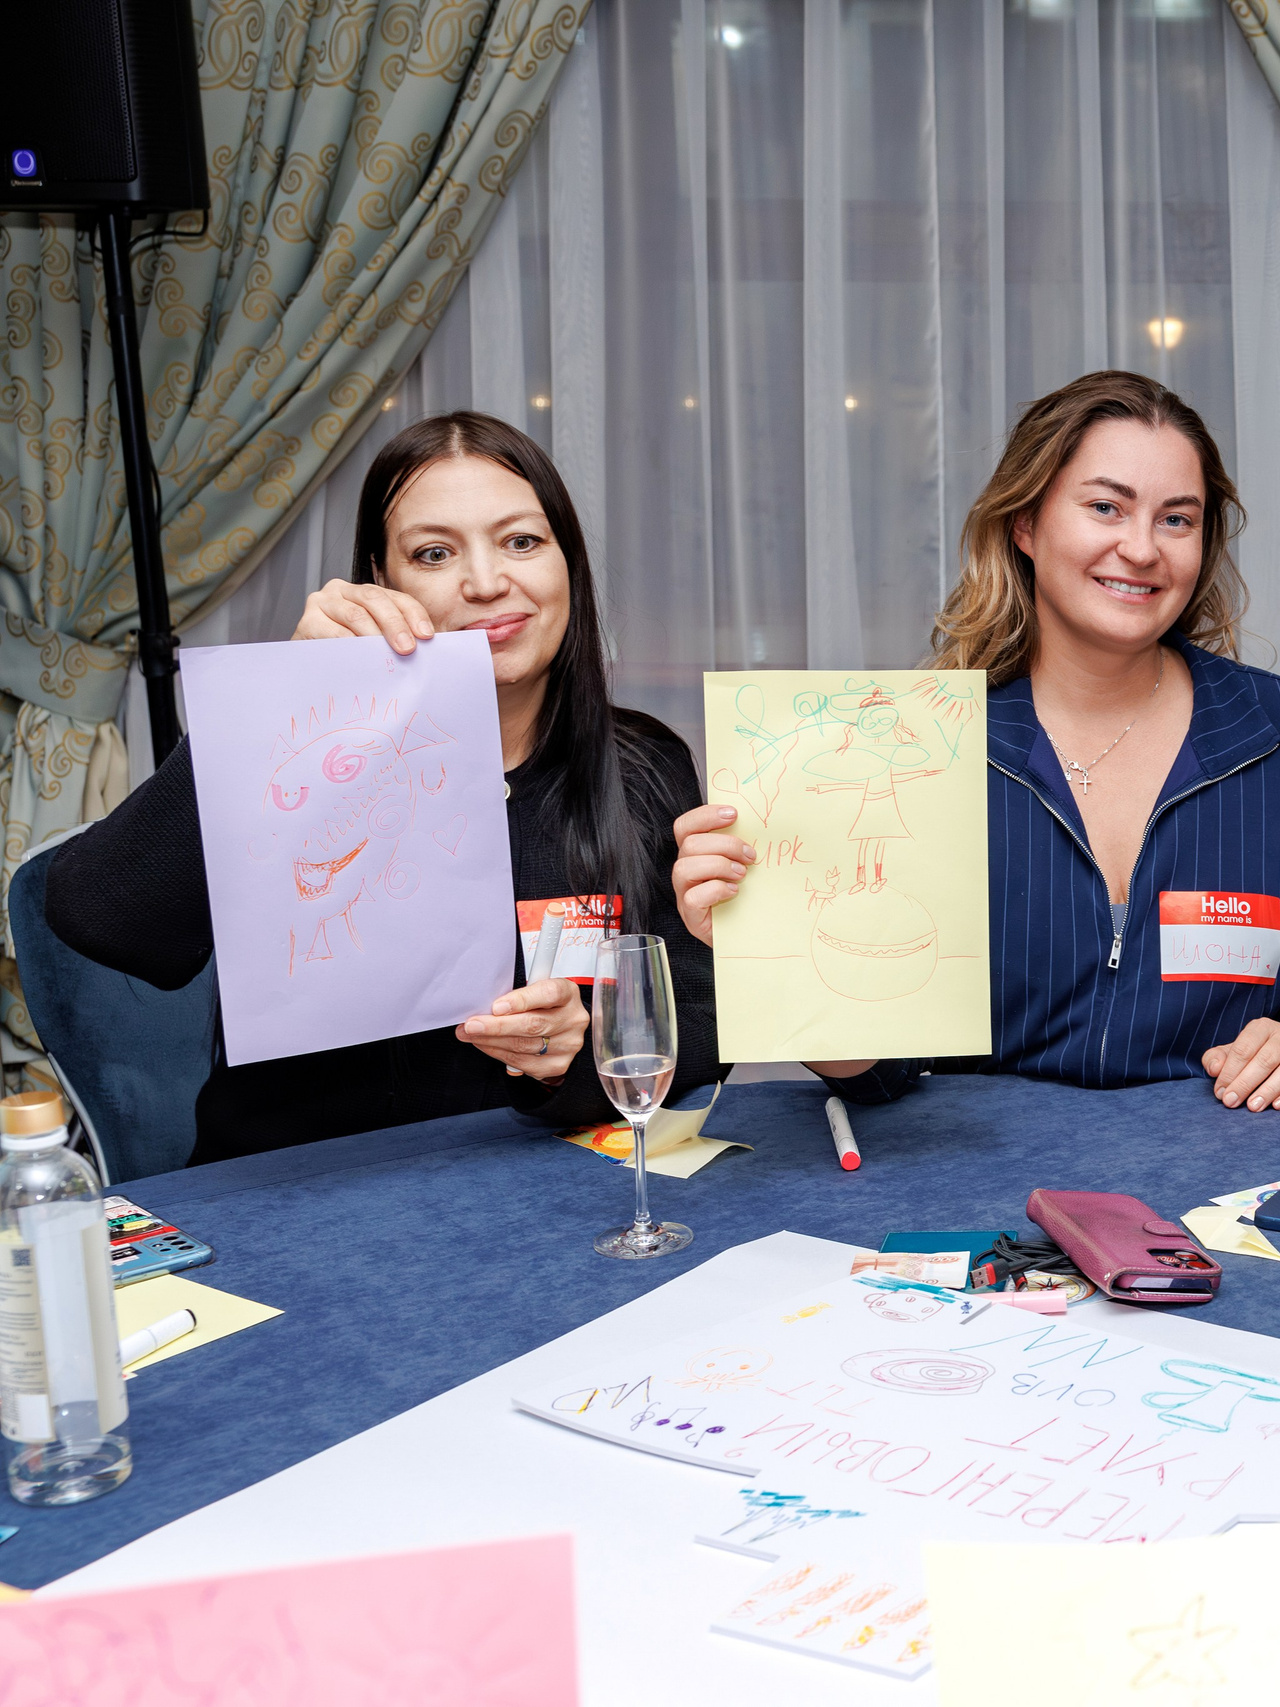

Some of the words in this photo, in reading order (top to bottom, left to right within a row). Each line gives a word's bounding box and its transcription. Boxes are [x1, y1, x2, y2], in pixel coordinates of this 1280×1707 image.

[561, 899, 615, 917] Hello
[1201, 896, 1252, 915] Hello
[563, 919, 578, 928] my
[1200, 915, 1215, 924] my
[1217, 915, 1244, 924] name
[1245, 915, 1252, 925] is
